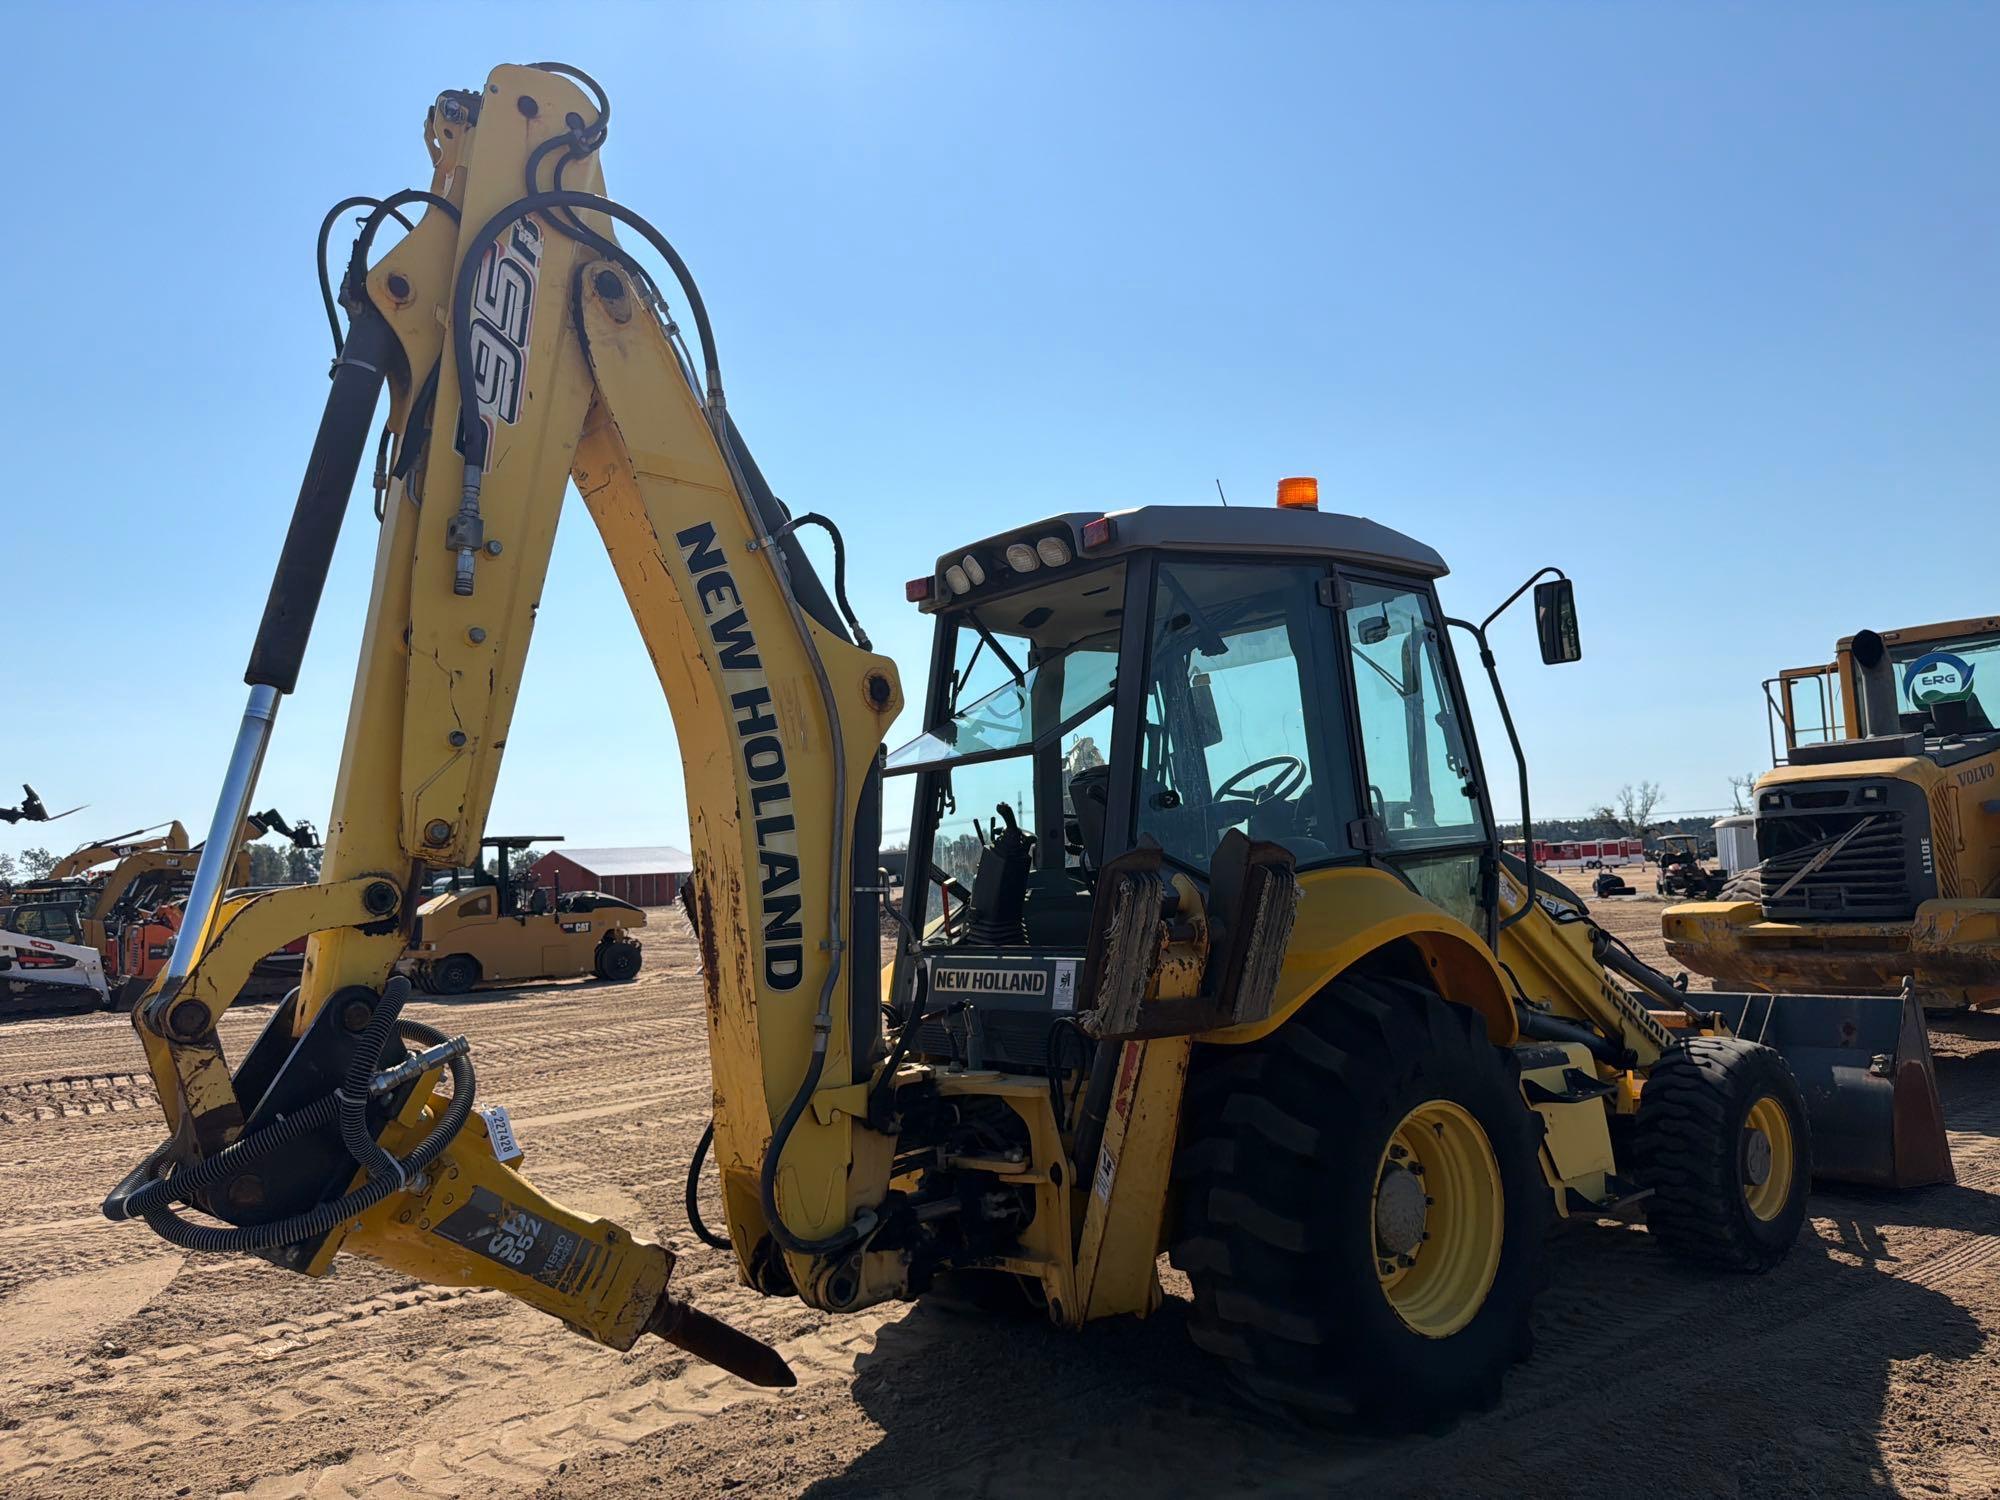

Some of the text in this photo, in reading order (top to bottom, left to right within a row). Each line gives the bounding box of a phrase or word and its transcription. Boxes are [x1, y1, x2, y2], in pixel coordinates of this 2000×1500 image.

[1922, 673, 1956, 686] ERG
[674, 520, 804, 992] NEW HOLLAND
[1956, 762, 1995, 787] VOLVO
[575, 922, 590, 932] CAT
[935, 970, 969, 989] NEW
[971, 971, 1045, 992] HOLLAND
[493, 1116, 513, 1153] 227428
[510, 1220, 543, 1265] 552
